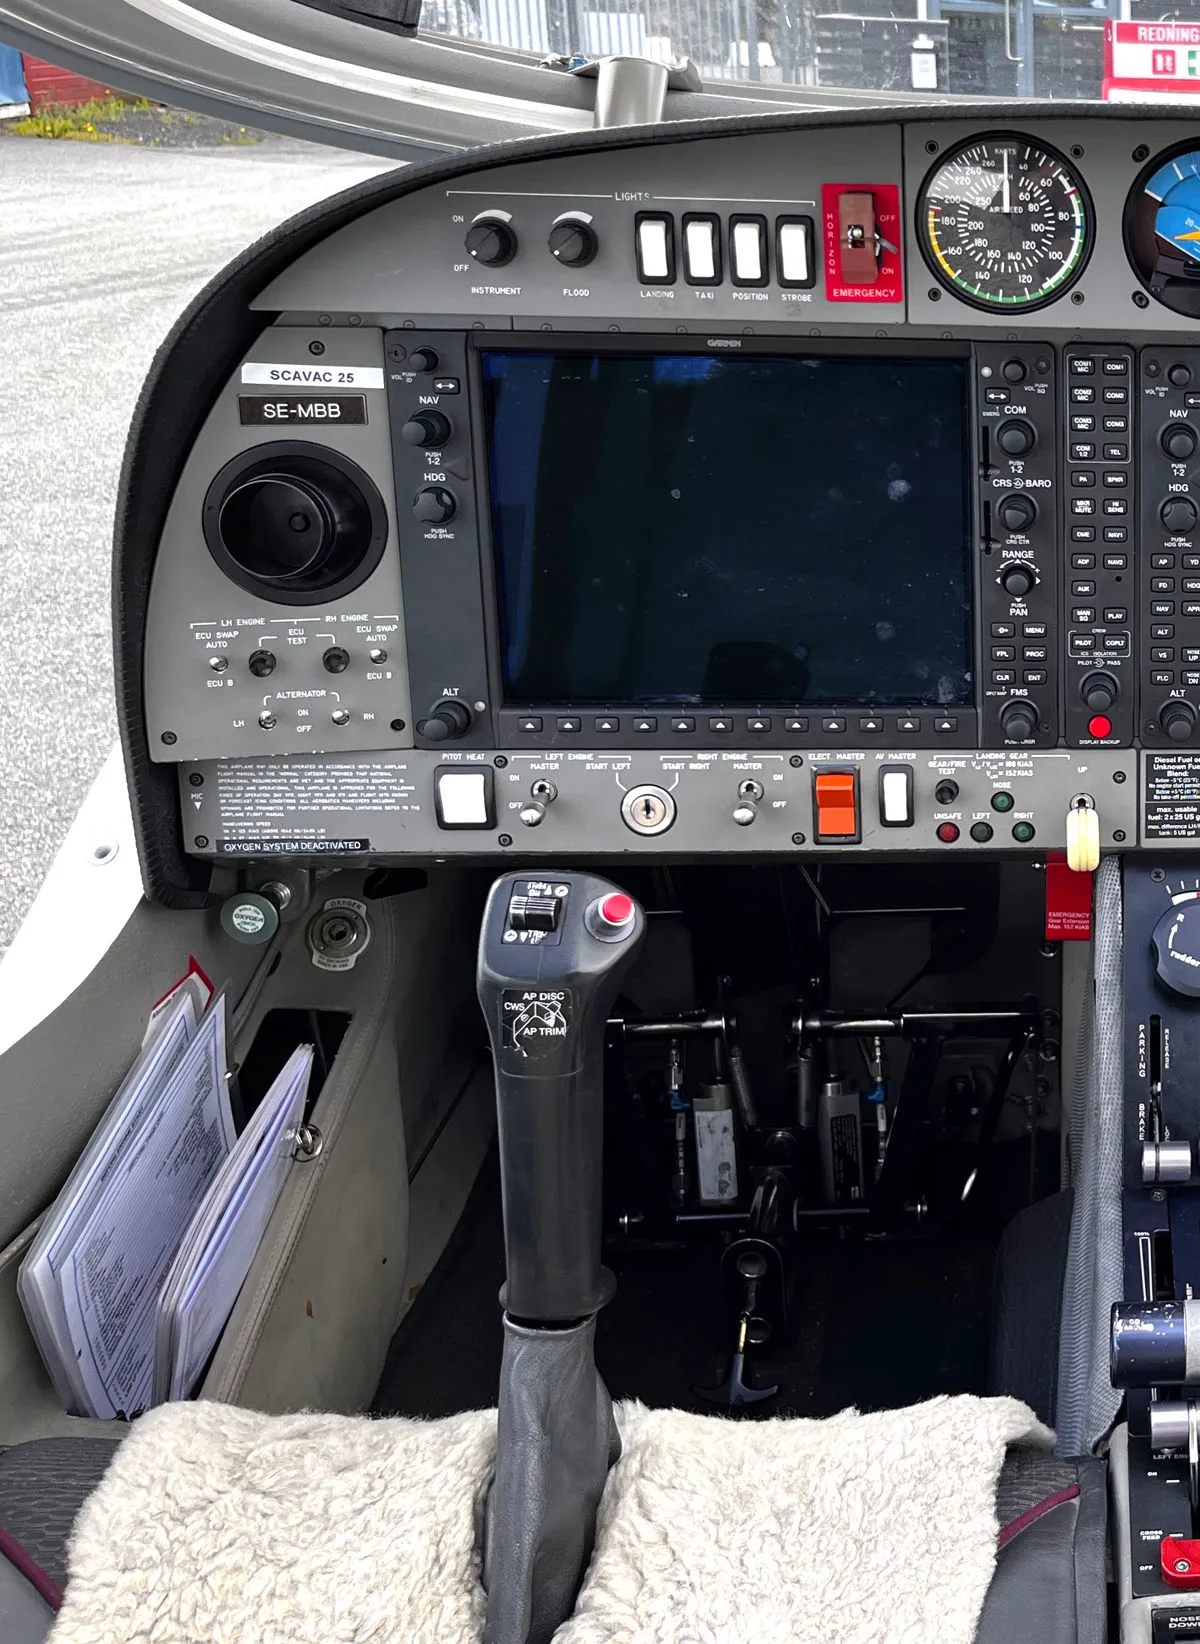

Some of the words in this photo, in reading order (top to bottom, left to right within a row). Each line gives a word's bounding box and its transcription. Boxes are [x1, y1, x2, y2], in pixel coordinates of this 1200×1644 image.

[965, 167, 981, 176] 240
[955, 177, 971, 185] 220
[1040, 178, 1052, 187] 60
[615, 191, 650, 202] LIGHTS
[945, 195, 960, 204] 200
[941, 217, 956, 225] 180
[1058, 212, 1069, 221] 80
[968, 221, 983, 230] 200
[1031, 223, 1044, 232] 100
[827, 213, 835, 276] HORIZON
[974, 238, 988, 247] 180
[1022, 241, 1035, 249] 120
[948, 246, 962, 255] 160
[1049, 252, 1062, 260] 100
[454, 264, 469, 272] OFF
[882, 267, 894, 275] ON
[975, 271, 990, 280] 140
[1019, 274, 1032, 283] 120
[471, 286, 521, 295] INSTRUMENT
[563, 288, 590, 297] FLOOD
[640, 290, 674, 299] LANDING
[833, 288, 895, 299] EMERGENCY
[695, 292, 714, 300] TAXI
[732, 293, 768, 301] POSITION
[781, 294, 812, 302] STROBE
[707, 339, 741, 347] GARMIN
[270, 370, 332, 382] SCAVAC
[338, 373, 354, 382] 25
[419, 396, 439, 404] NAV
[263, 404, 341, 418] SE-MBB
[424, 473, 445, 482] HDG
[993, 479, 1012, 488] CRS
[1026, 479, 1051, 488] BARO
[1002, 551, 1034, 559] RANGE
[1010, 608, 1028, 616] PAN
[237, 618, 265, 626] ENGINE
[341, 614, 368, 622] ENGINE
[277, 690, 326, 698] ALTERNATOR
[224, 843, 261, 851] OXYGEN
[263, 842, 299, 851] SYSTEM
[301, 841, 361, 850] DEACTIVATED
[1170, 950, 1200, 968] rudder
[539, 992, 565, 1000] DISC
[504, 1003, 525, 1011] CWS
